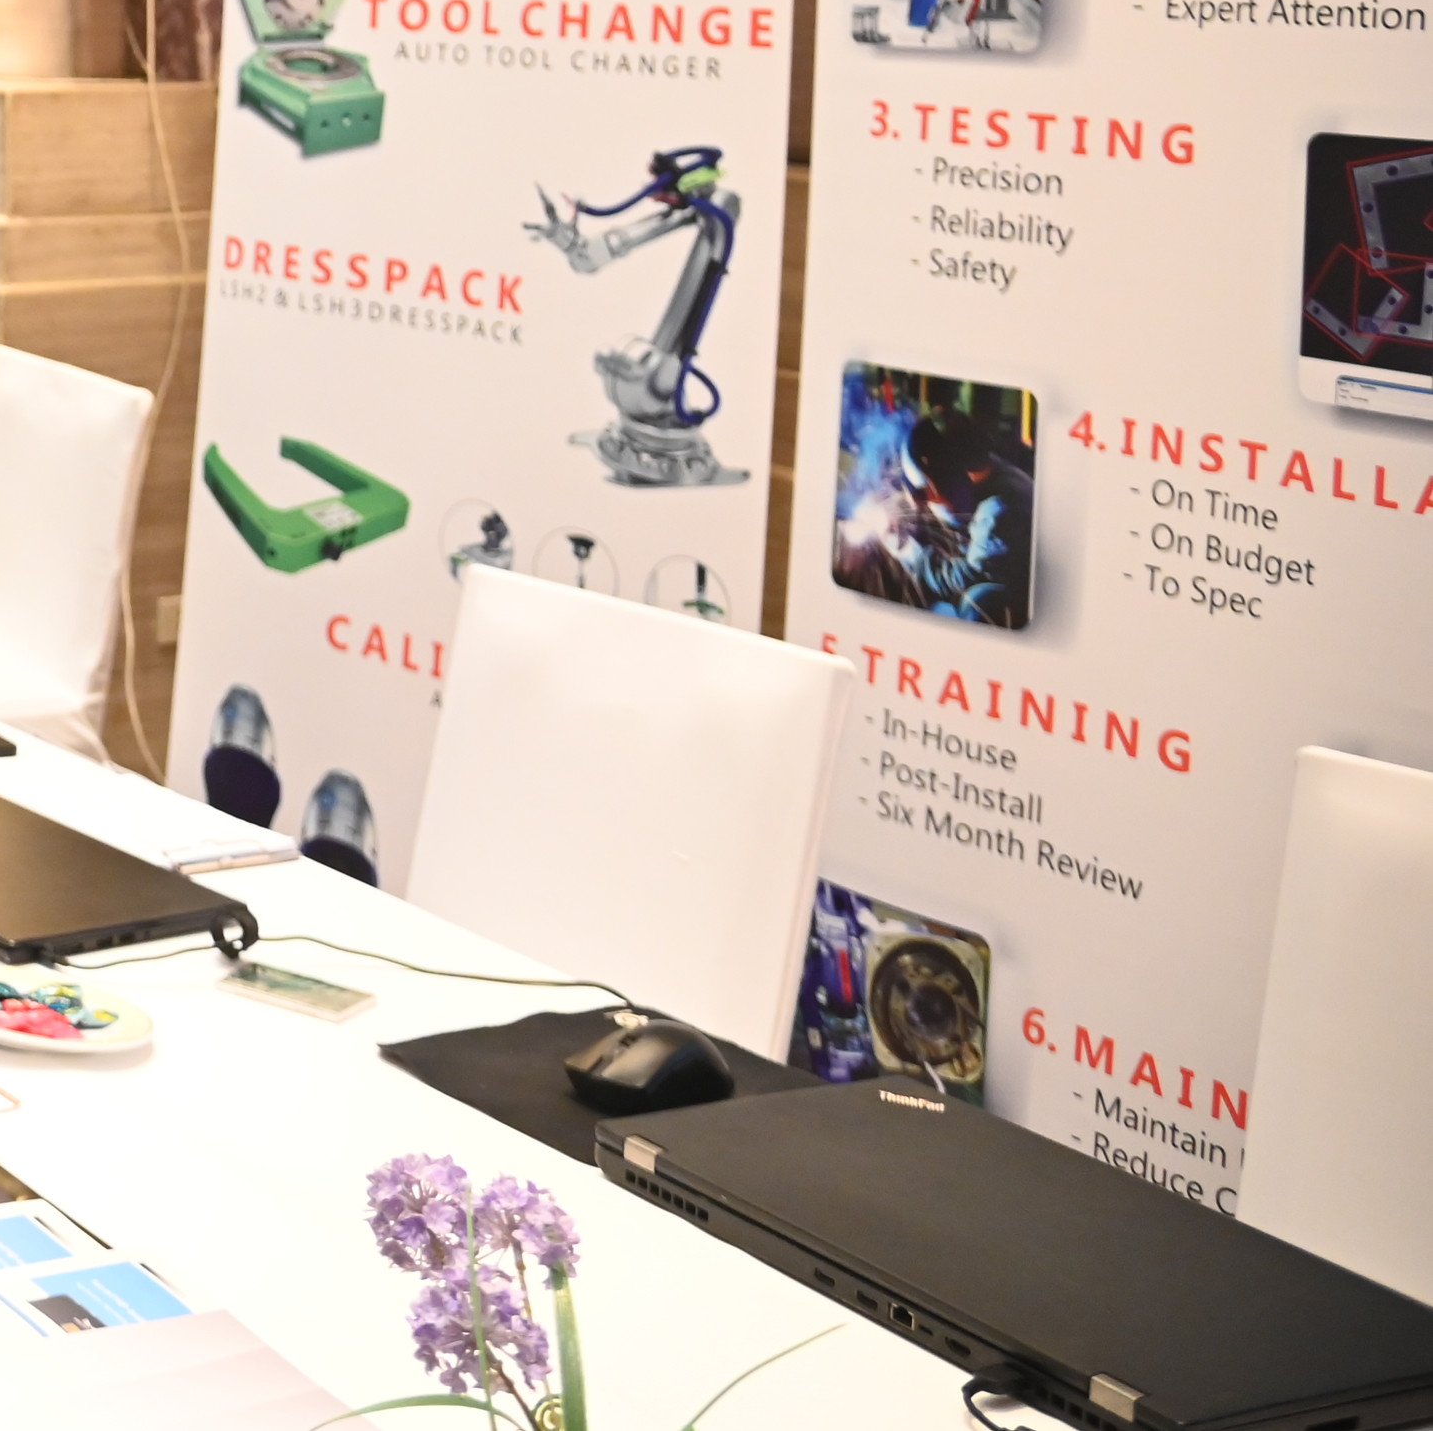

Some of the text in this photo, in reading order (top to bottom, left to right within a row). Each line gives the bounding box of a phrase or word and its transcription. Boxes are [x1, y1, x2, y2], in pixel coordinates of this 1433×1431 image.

[394, 42, 723, 79] AUTO TOOL CHANGER
[932, 157, 1064, 196] Precision
[930, 206, 1073, 255] Reliability
[224, 237, 524, 314] DRESSPACK
[929, 248, 1017, 293] Safety
[1151, 479, 1279, 532] On Time
[1150, 522, 1316, 588] On Budget
[1144, 563, 1264, 619] To Spec
[326, 614, 445, 679] CALI
[882, 708, 1018, 770] In-House
[879, 751, 1043, 824] Post-Install
[876, 790, 1144, 900] Six Month Review
[879, 1089, 945, 1114] ThinkPad
[1095, 1087, 1227, 1169] Maintain
[1094, 1131, 1204, 1203] Reduce
